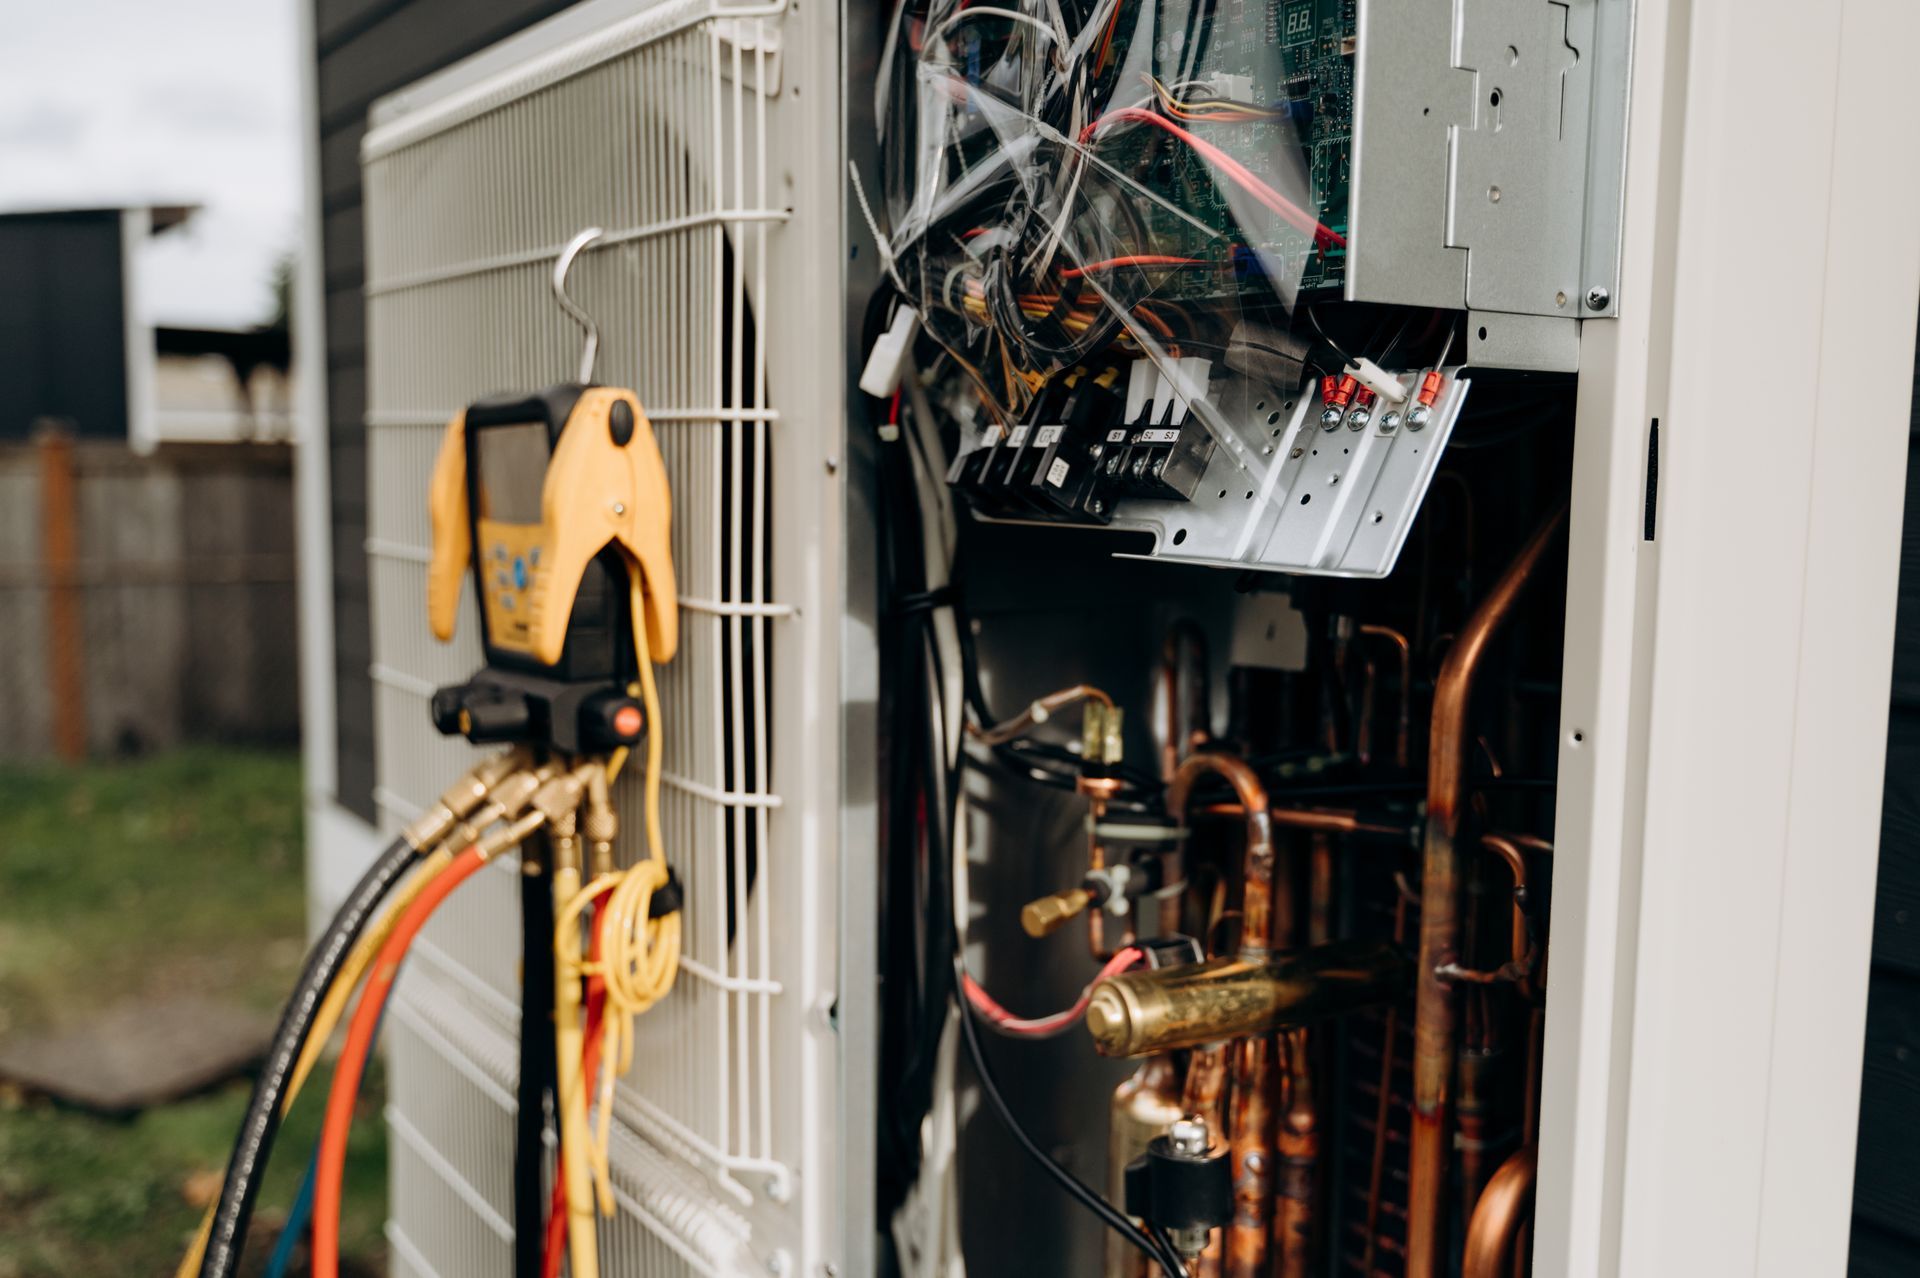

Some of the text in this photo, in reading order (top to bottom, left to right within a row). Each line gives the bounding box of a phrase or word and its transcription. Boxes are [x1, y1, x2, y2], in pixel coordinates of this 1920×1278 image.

[1111, 431, 1122, 440] S1
[1143, 431, 1175, 440] S2 S3
